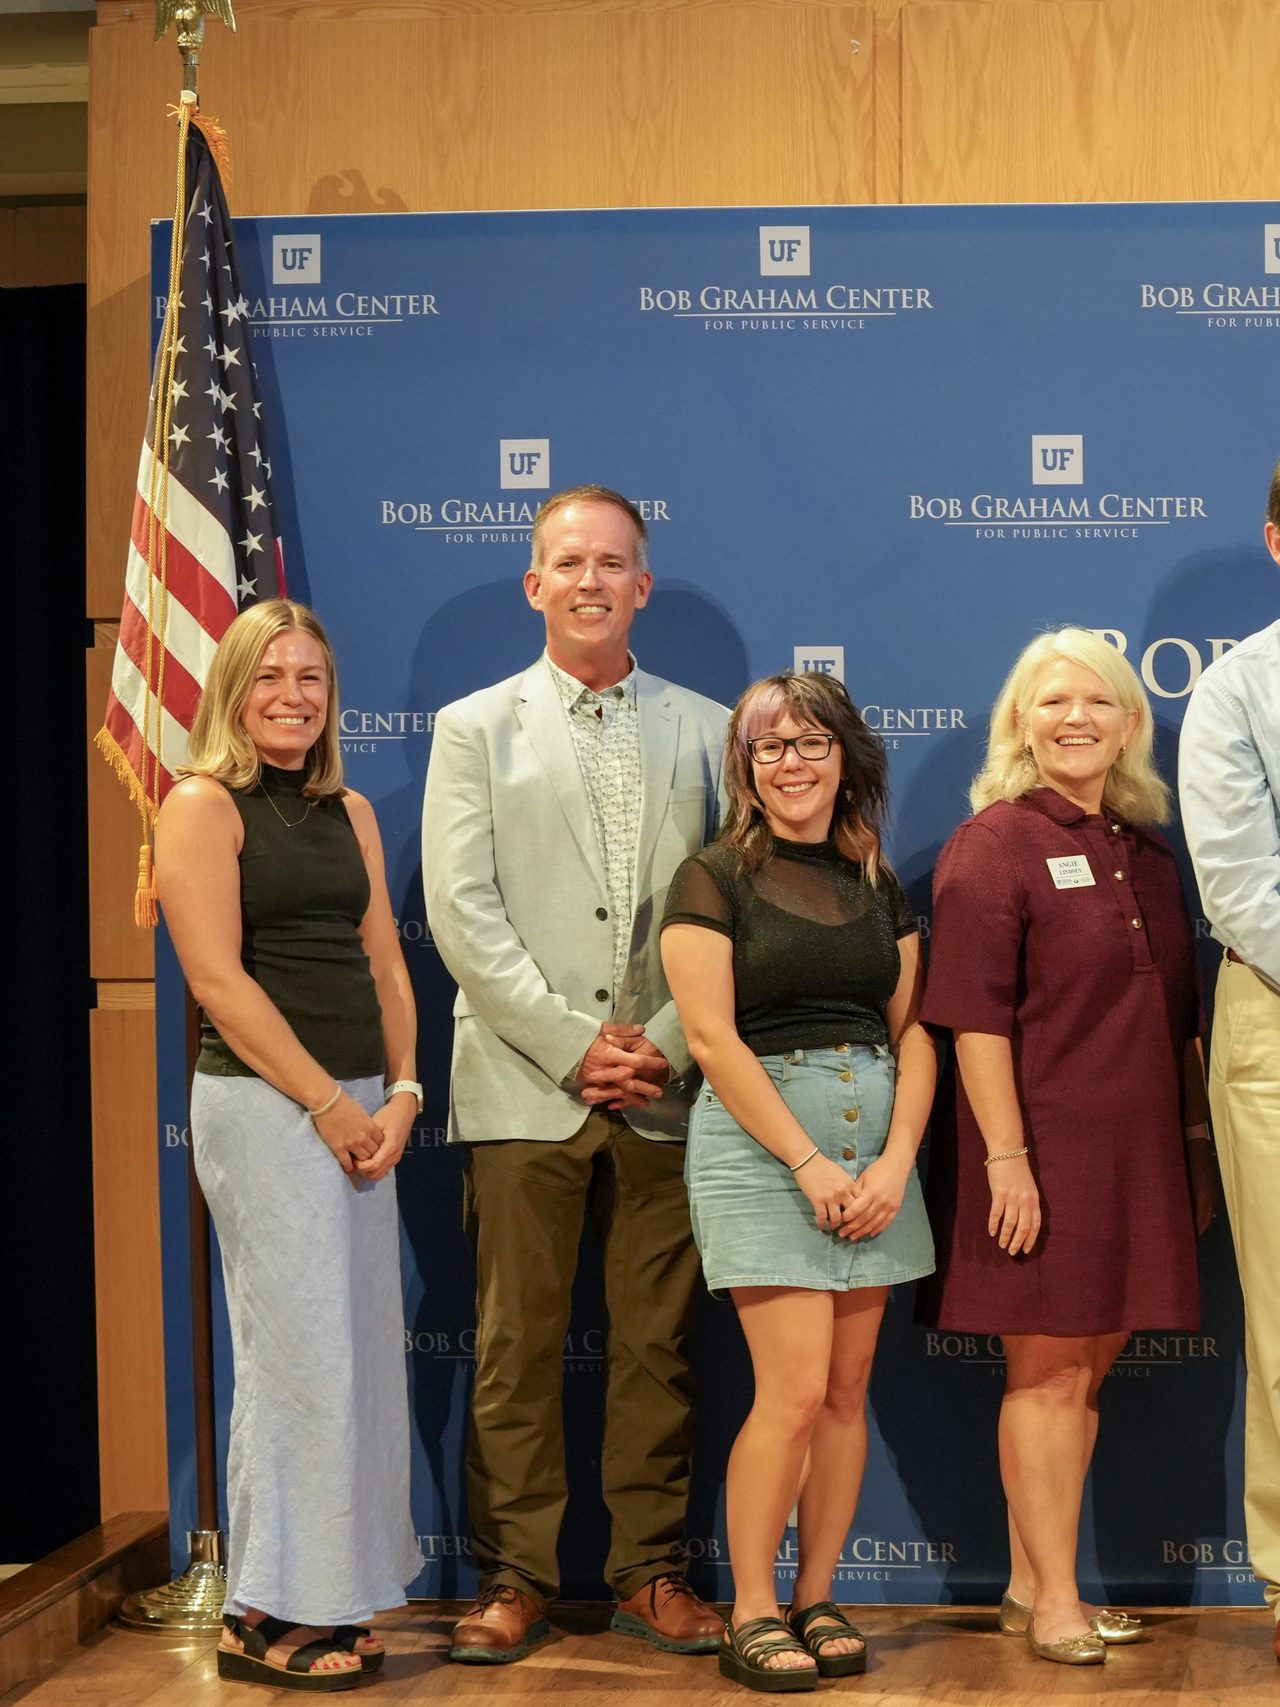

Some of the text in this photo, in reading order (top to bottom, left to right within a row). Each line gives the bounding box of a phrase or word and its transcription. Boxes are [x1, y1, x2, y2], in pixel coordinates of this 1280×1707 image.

[281, 248, 312, 271] UF
[768, 239, 801, 262] UF
[335, 292, 440, 316] CENTER
[639, 285, 934, 311] BOB GRAHAM CENTER
[1140, 284, 1195, 308] BOB
[253, 325, 374, 338] PUBLIC SERVICE
[704, 319, 866, 331] FOR PUBLIC SERVICE
[1208, 317, 1238, 328] FOR
[508, 453, 541, 475] UF
[1041, 448, 1074, 471] UF
[381, 499, 541, 524] BOB GRAHA
[909, 493, 1208, 519] BOB GRAHAM CENTER
[445, 533, 474, 544] FOR
[975, 528, 1139, 539] FOR PUBLIC SERVICE
[861, 705, 968, 729] CENTER
[926, 1333, 978, 1358] BOB
[853, 1538, 957, 1563] CENTER
[1162, 1540, 1214, 1565] BOB
[1227, 1573, 1257, 1584] FOR
